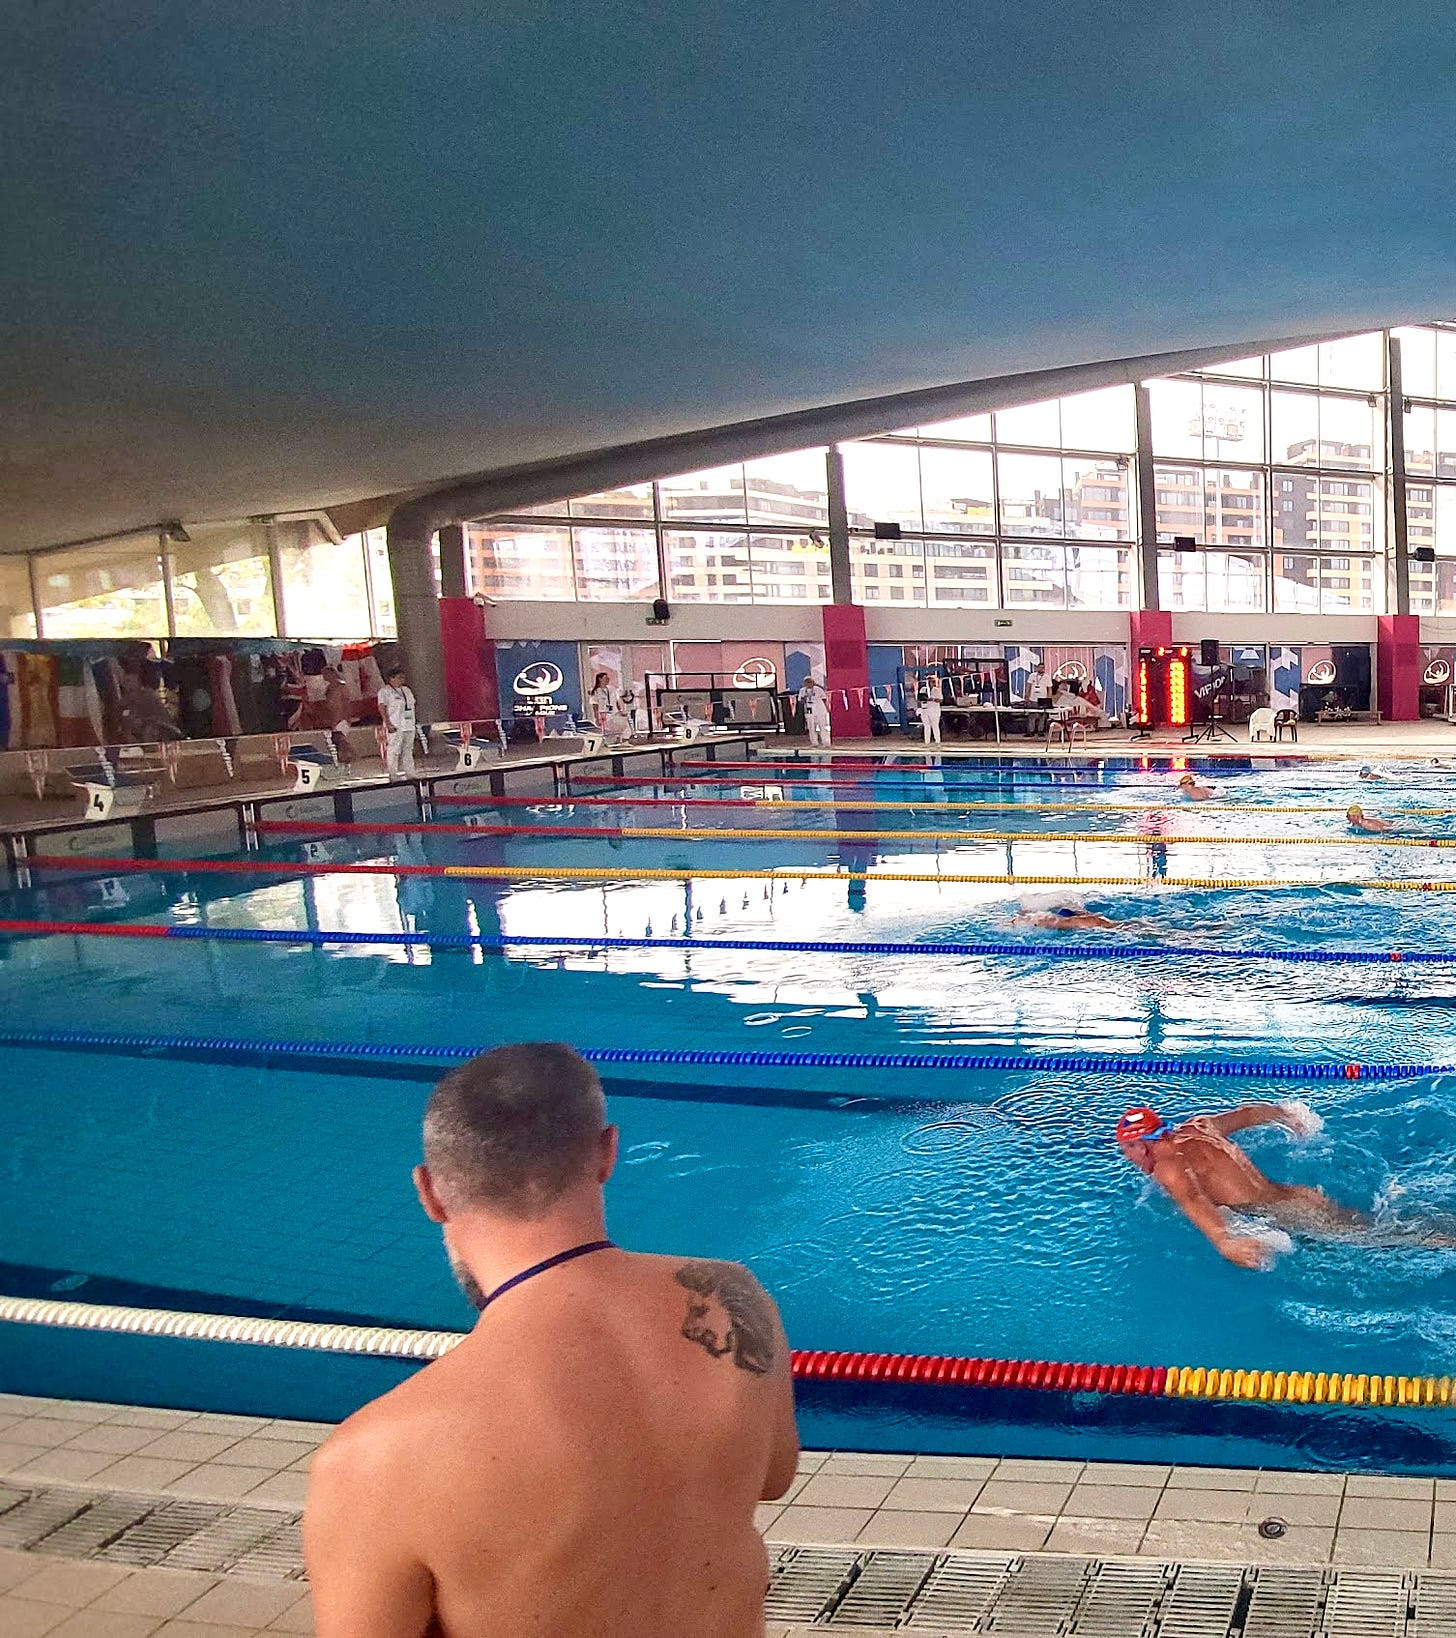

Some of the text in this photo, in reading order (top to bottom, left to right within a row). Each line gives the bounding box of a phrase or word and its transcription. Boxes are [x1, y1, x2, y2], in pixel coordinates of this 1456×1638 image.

[513, 704, 568, 712] CHAPIONS
[685, 728, 692, 739] 8
[588, 739, 595, 752] 7
[464, 753, 472, 767] 6
[301, 769, 310, 785] 5
[93, 793, 104, 812] 4
